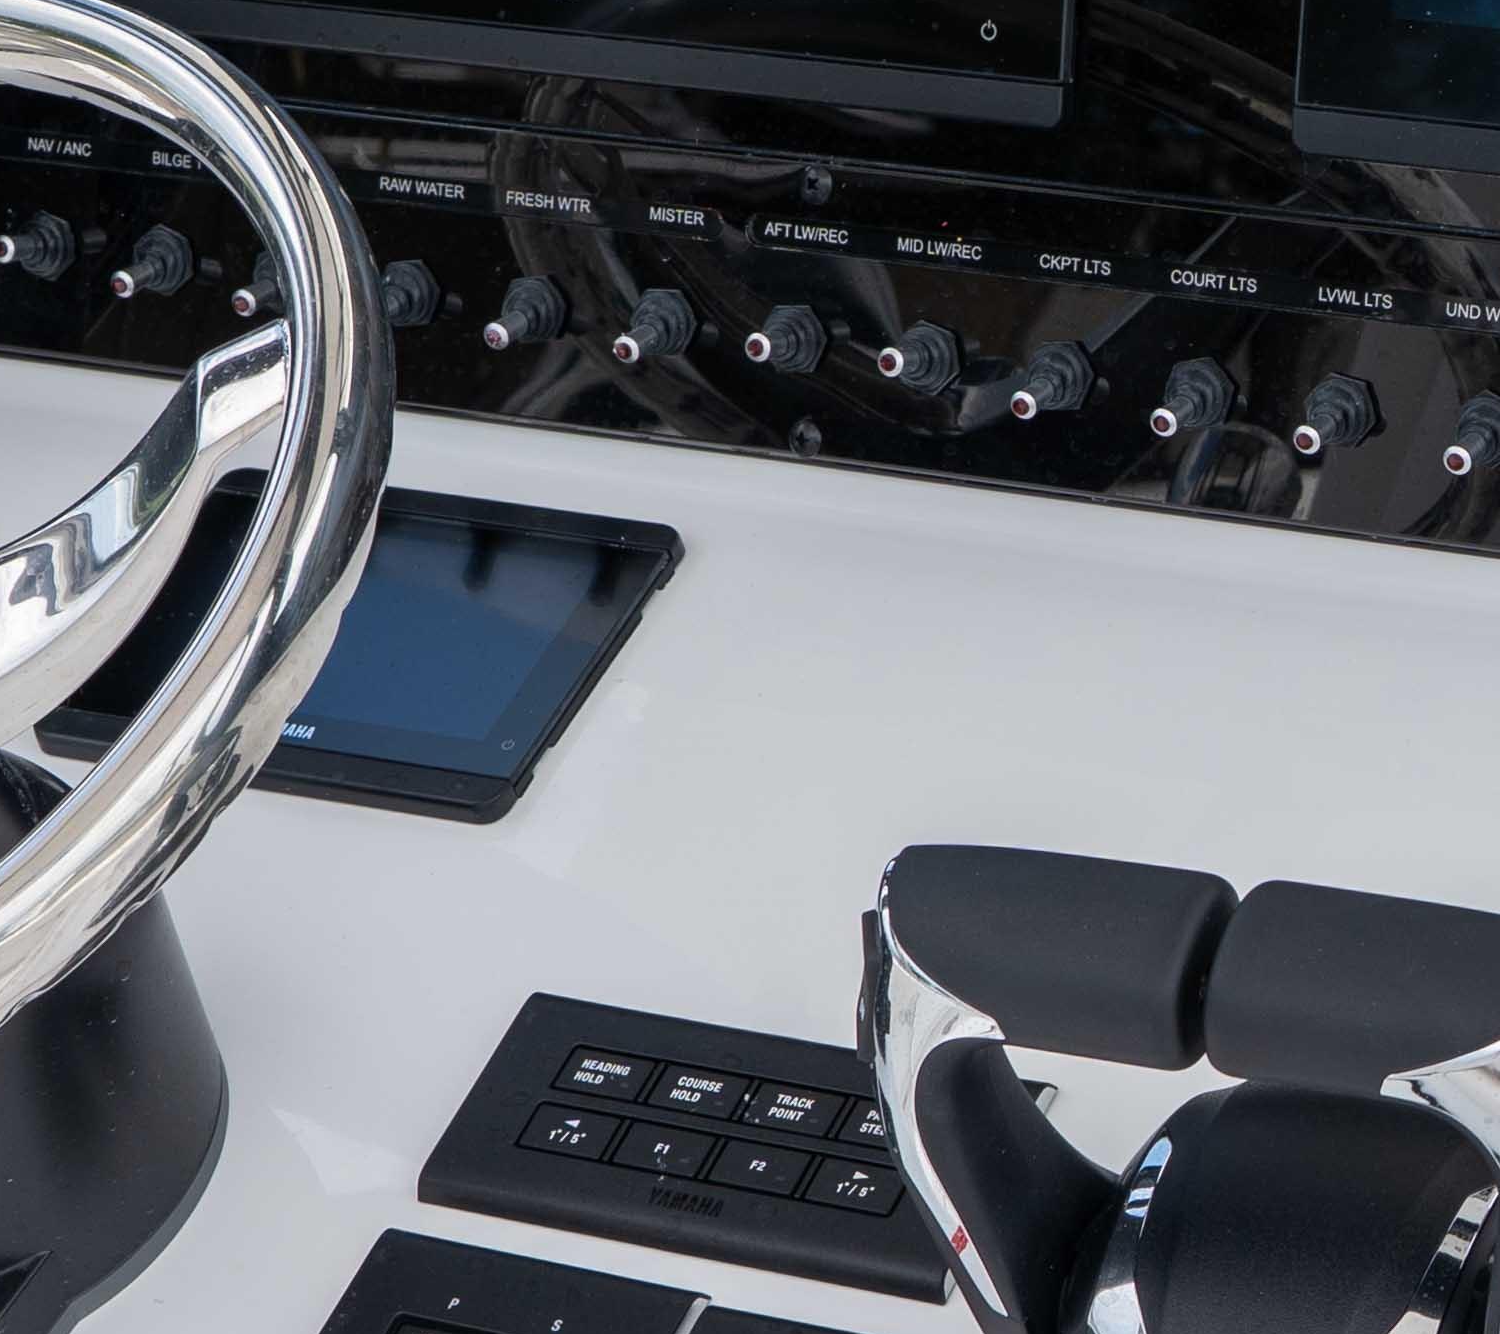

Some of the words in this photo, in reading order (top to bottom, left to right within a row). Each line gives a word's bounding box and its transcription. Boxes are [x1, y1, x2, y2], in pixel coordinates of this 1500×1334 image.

[28, 137, 54, 153] NAV
[64, 141, 92, 157] ANC
[152, 151, 191, 168] BILGE
[379, 176, 412, 193] RAW
[415, 180, 465, 199] WATER
[506, 190, 554, 210] FRESH
[557, 196, 591, 214] WTR
[649, 206, 705, 226] MISTER
[764, 221, 792, 238] AFT
[795, 224, 849, 245] LW/REC
[897, 237, 924, 254] MID
[927, 240, 983, 260] LW/REC
[1039, 253, 1081, 272] CKPT
[1084, 259, 1111, 276] LTS
[1170, 269, 1226, 291] COURT
[1229, 276, 1258, 294] LTS
[1318, 286, 1361, 307] LVWL
[1364, 292, 1393, 310] LTS
[1446, 301, 1481, 320] UND
[581, 1058, 631, 1076] HEADING
[573, 1070, 604, 1085] HOLD
[678, 1076, 724, 1094] COURSE
[670, 1088, 701, 1103] HOLD
[776, 1094, 816, 1110] TRACK
[768, 1106, 805, 1122] POINT
[654, 1143, 670, 1155] F1
[749, 1160, 766, 1172] F2
[447, 1297, 460, 1310] P
[551, 1319, 563, 1332] S
